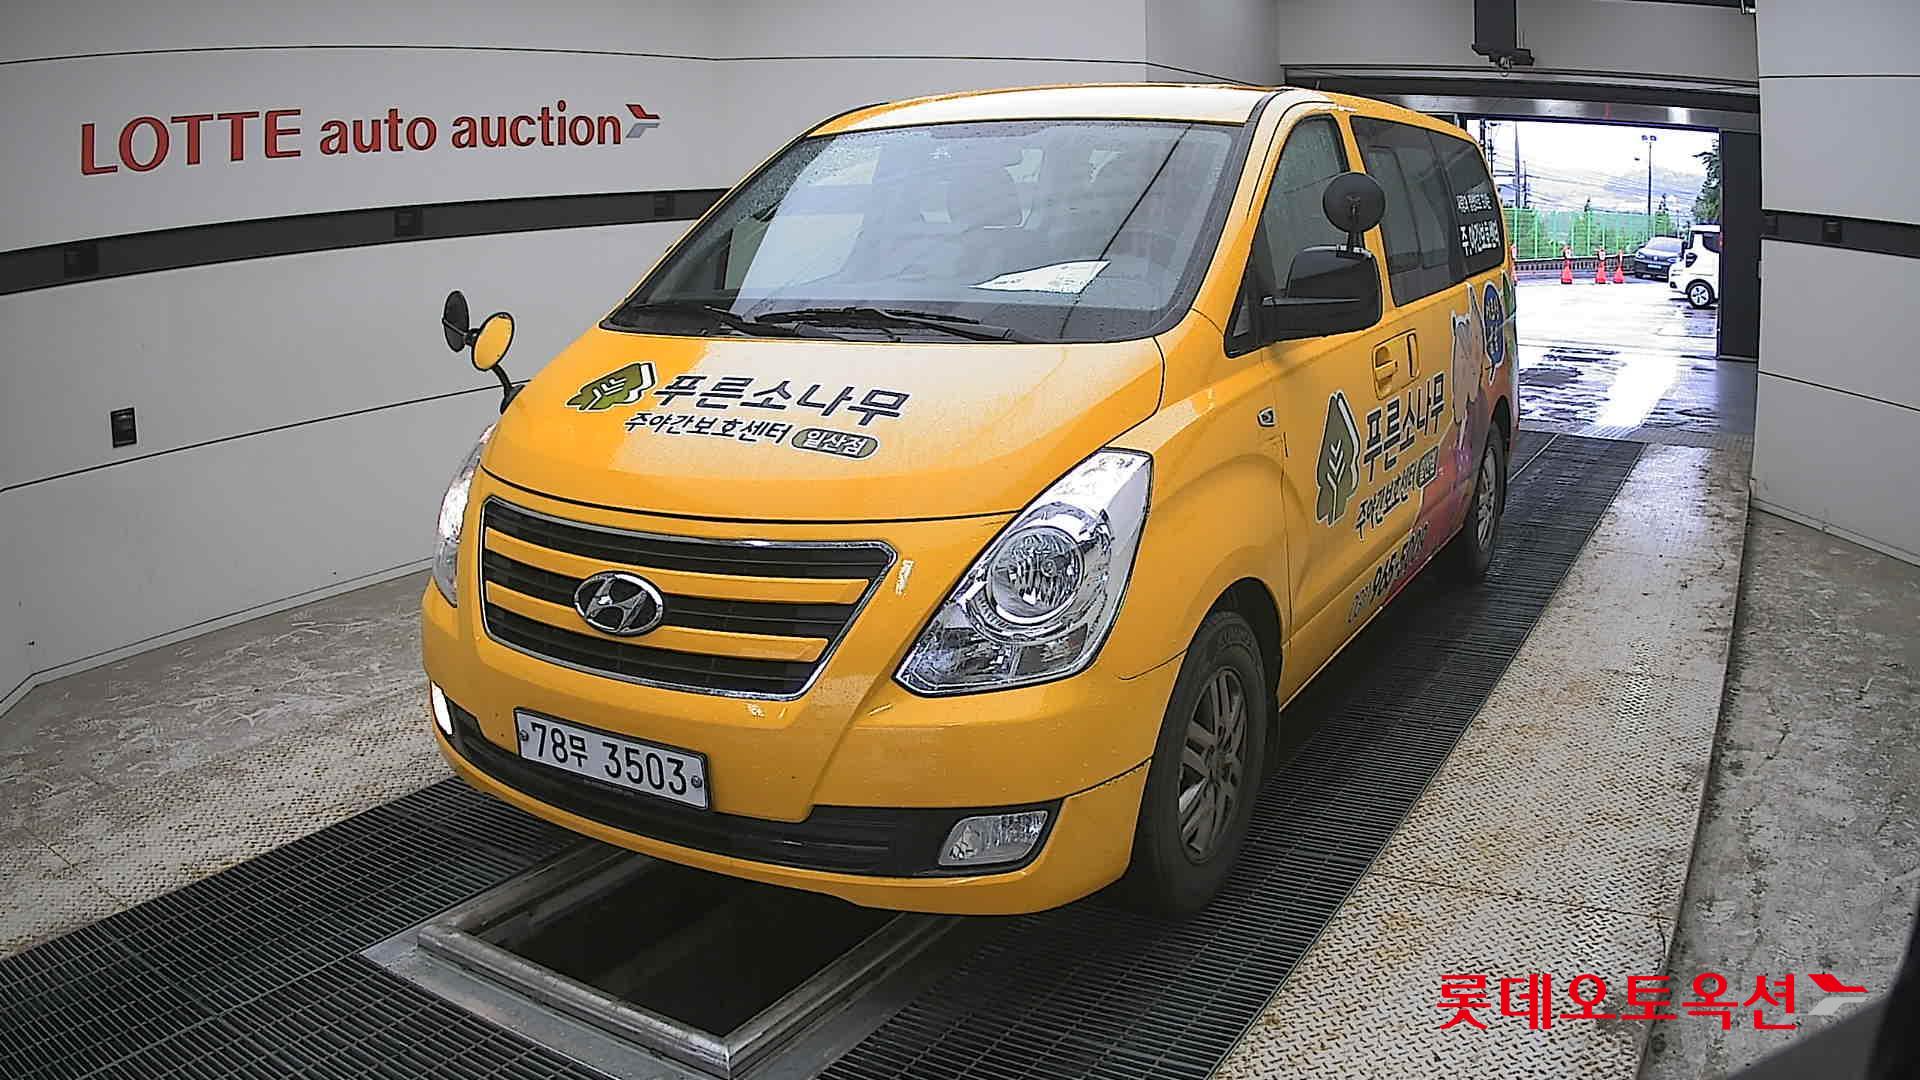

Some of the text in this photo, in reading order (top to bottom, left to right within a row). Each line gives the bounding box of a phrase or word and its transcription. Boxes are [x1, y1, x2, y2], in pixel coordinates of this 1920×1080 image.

[82, 99, 622, 176] LOTTE auto auction
[624, 413, 868, 455] 주야간보호센터 일산점
[654, 374, 911, 427] 푸른소나무
[1364, 373, 1445, 481] 푸른소나무
[531, 722, 688, 796] 78무 3503
